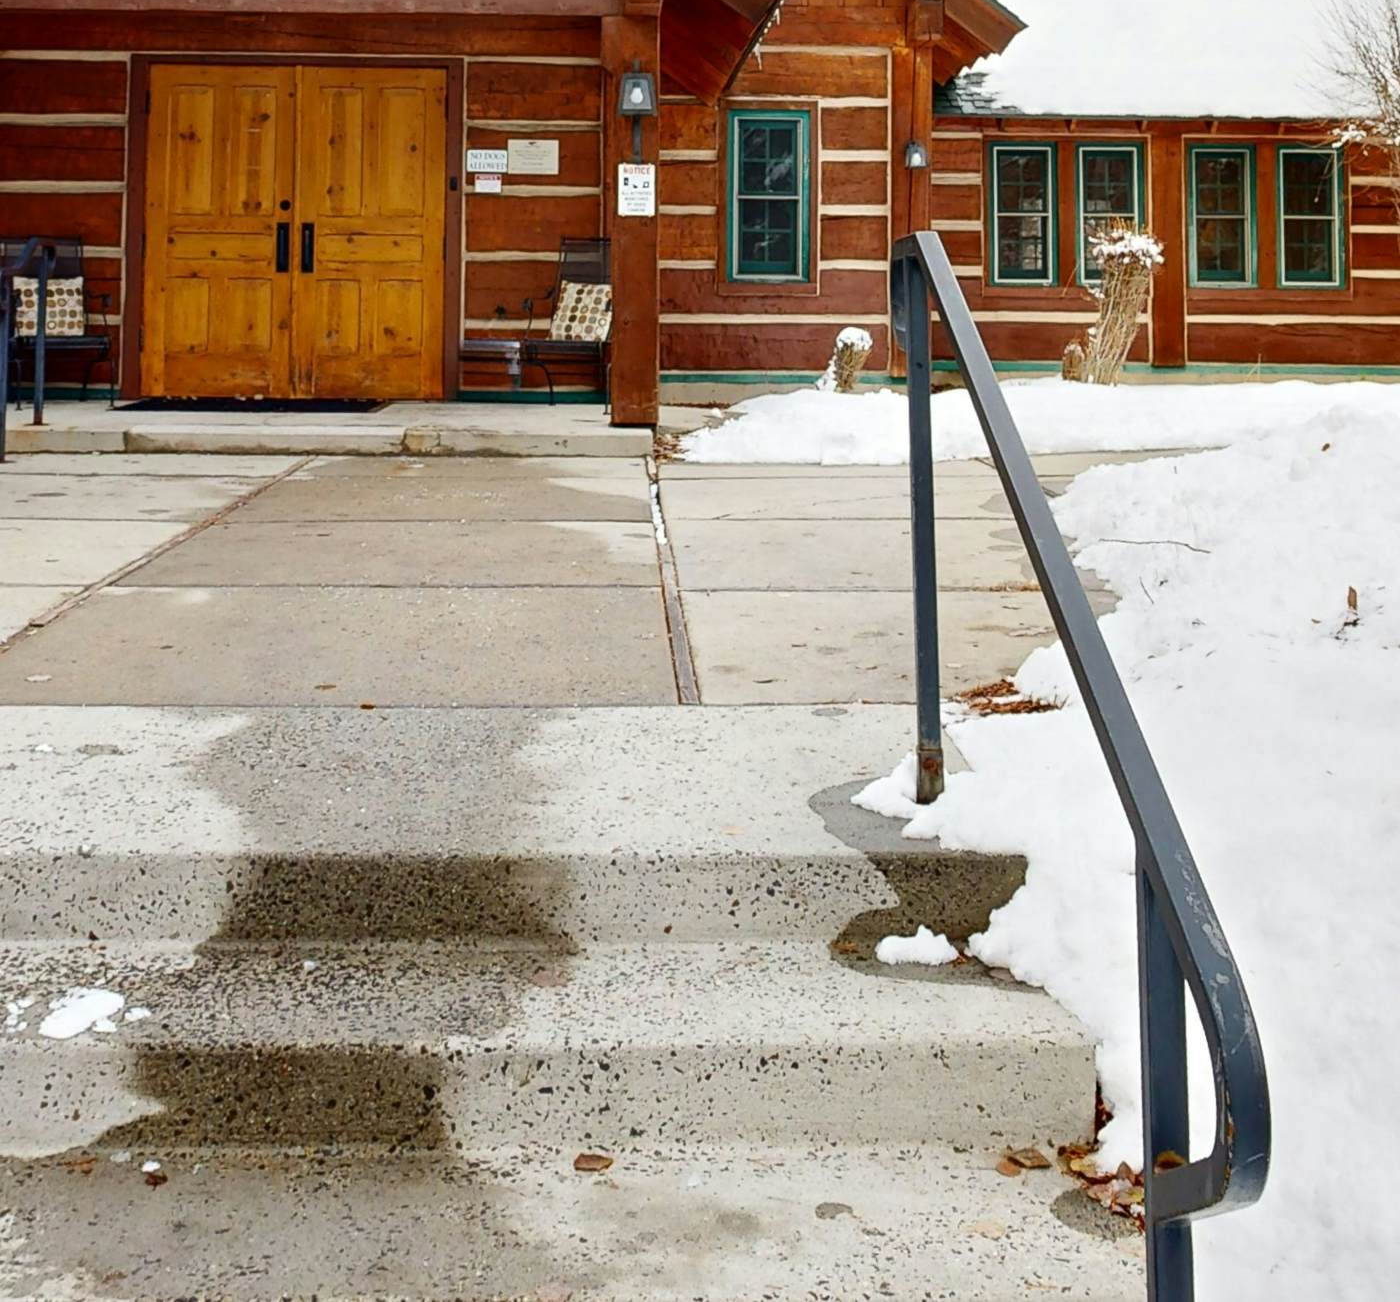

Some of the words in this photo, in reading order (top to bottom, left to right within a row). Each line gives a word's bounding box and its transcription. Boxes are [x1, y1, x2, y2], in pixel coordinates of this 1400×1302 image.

[470, 152, 482, 160] NO
[484, 152, 506, 160] DOGS
[470, 161, 507, 170] ALLOWED
[623, 166, 651, 175] NOTICE
